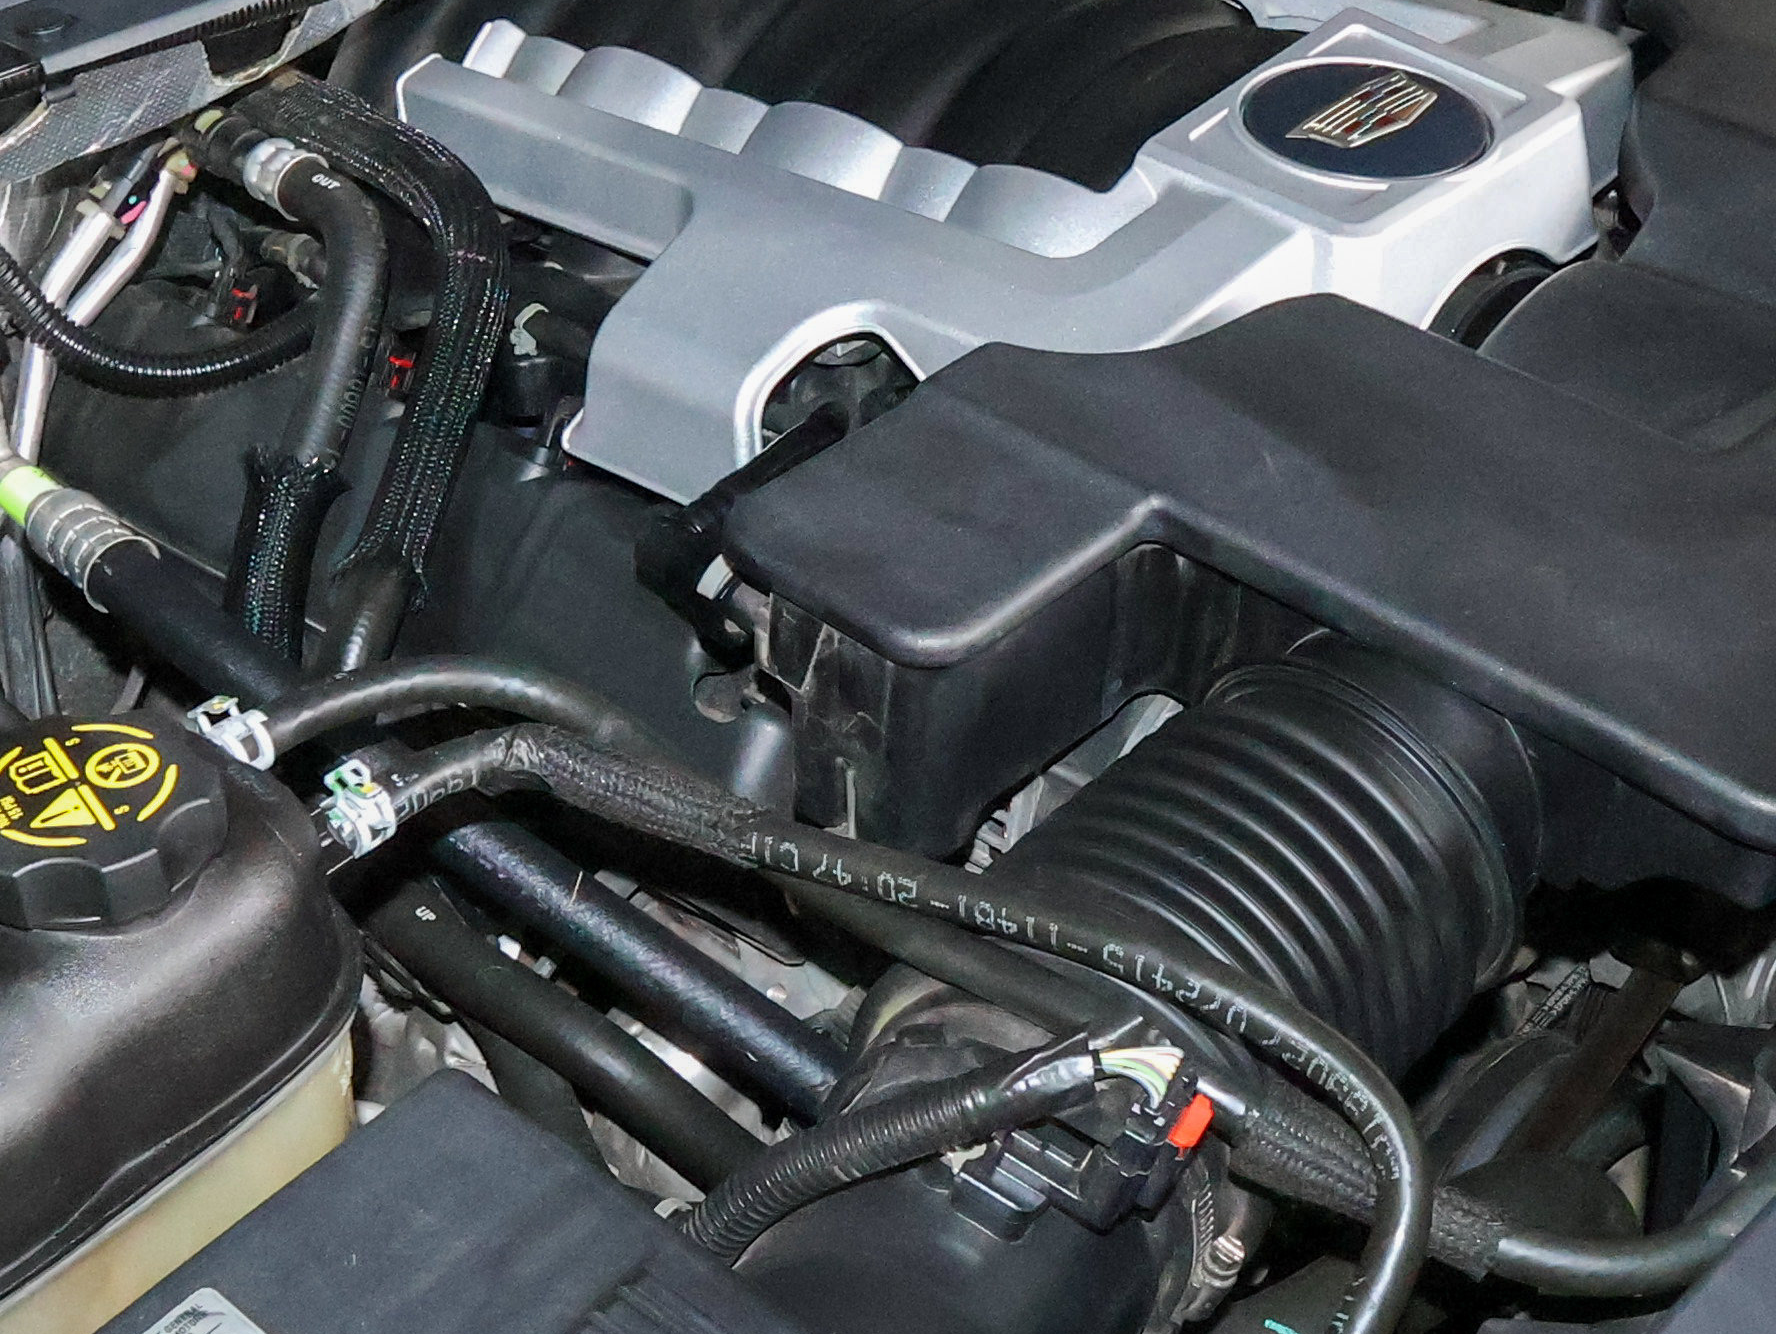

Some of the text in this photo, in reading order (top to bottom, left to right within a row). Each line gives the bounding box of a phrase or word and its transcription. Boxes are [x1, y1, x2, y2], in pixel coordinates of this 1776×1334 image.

[310, 171, 342, 191] OUT
[414, 903, 439, 924] UP
[162, 1298, 203, 1334] GENERAL
